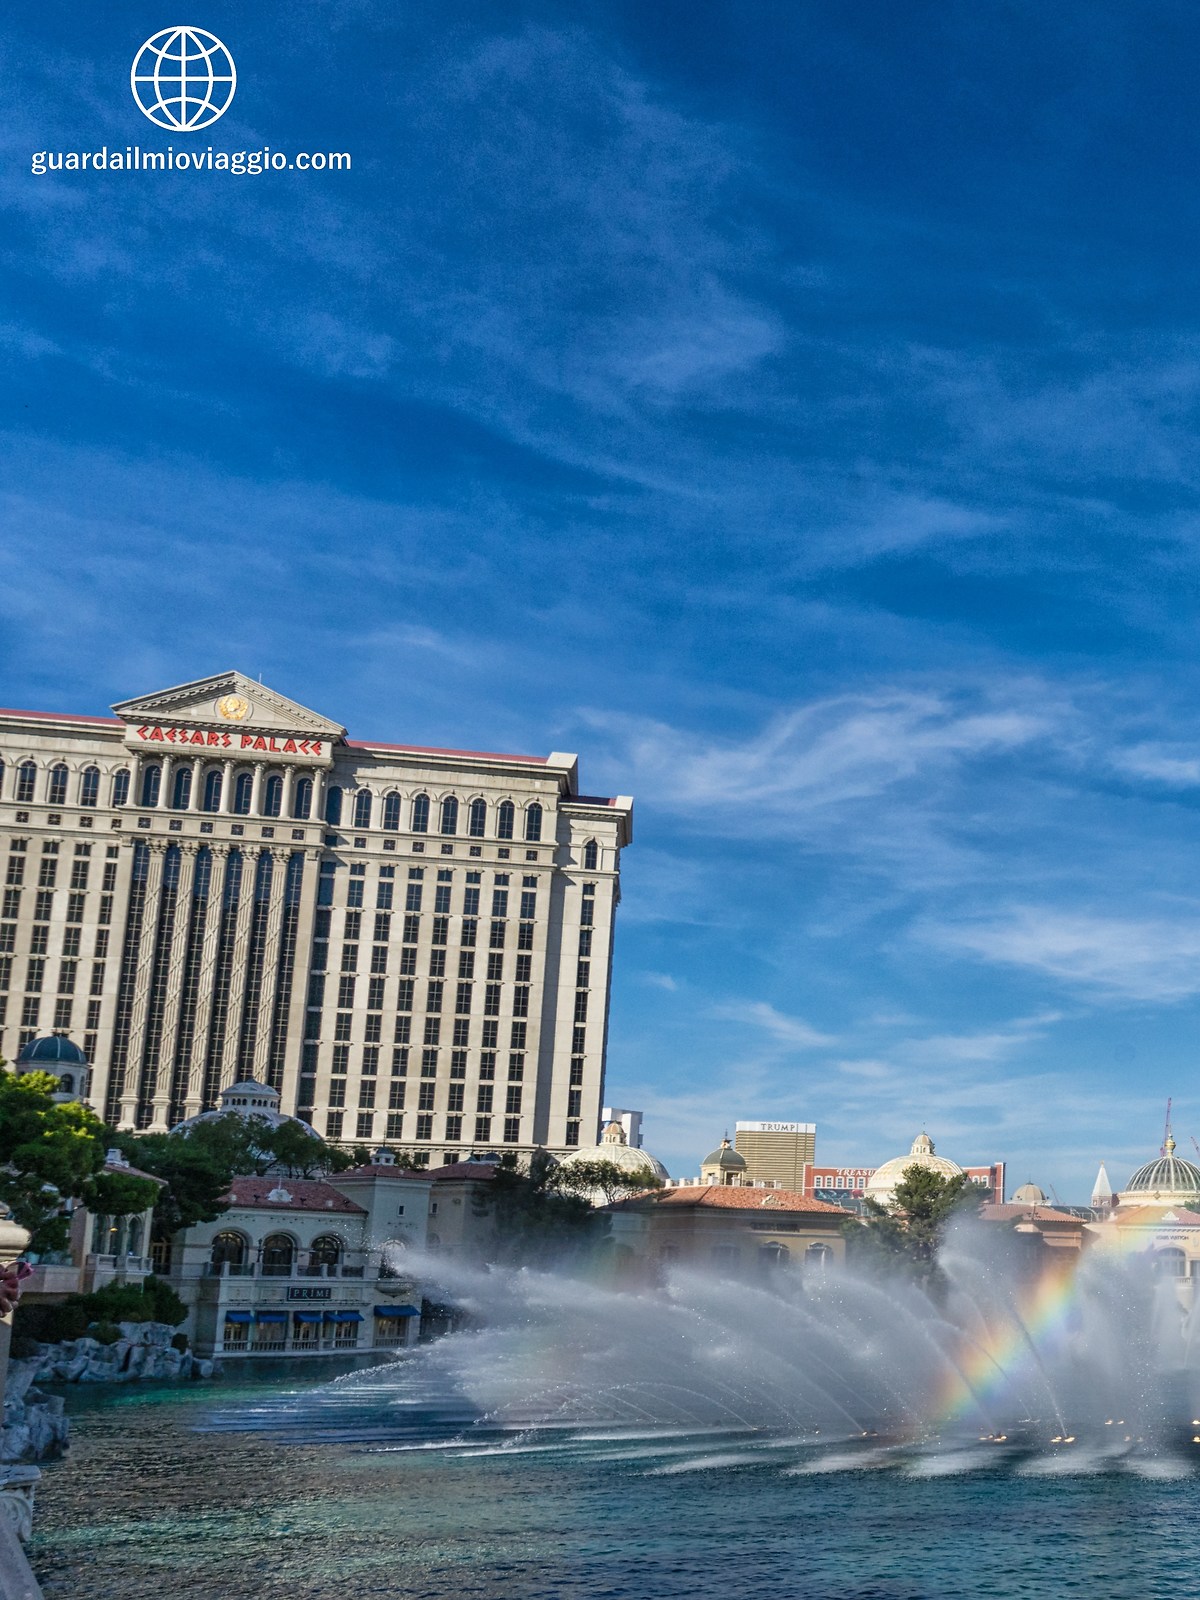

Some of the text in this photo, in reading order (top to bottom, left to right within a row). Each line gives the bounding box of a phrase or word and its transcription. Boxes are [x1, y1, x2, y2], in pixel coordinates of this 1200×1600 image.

[137, 724, 323, 756] CAESARS PALACE
[760, 1123, 796, 1132] TRUMP
[293, 1288, 330, 1298] PRIME
